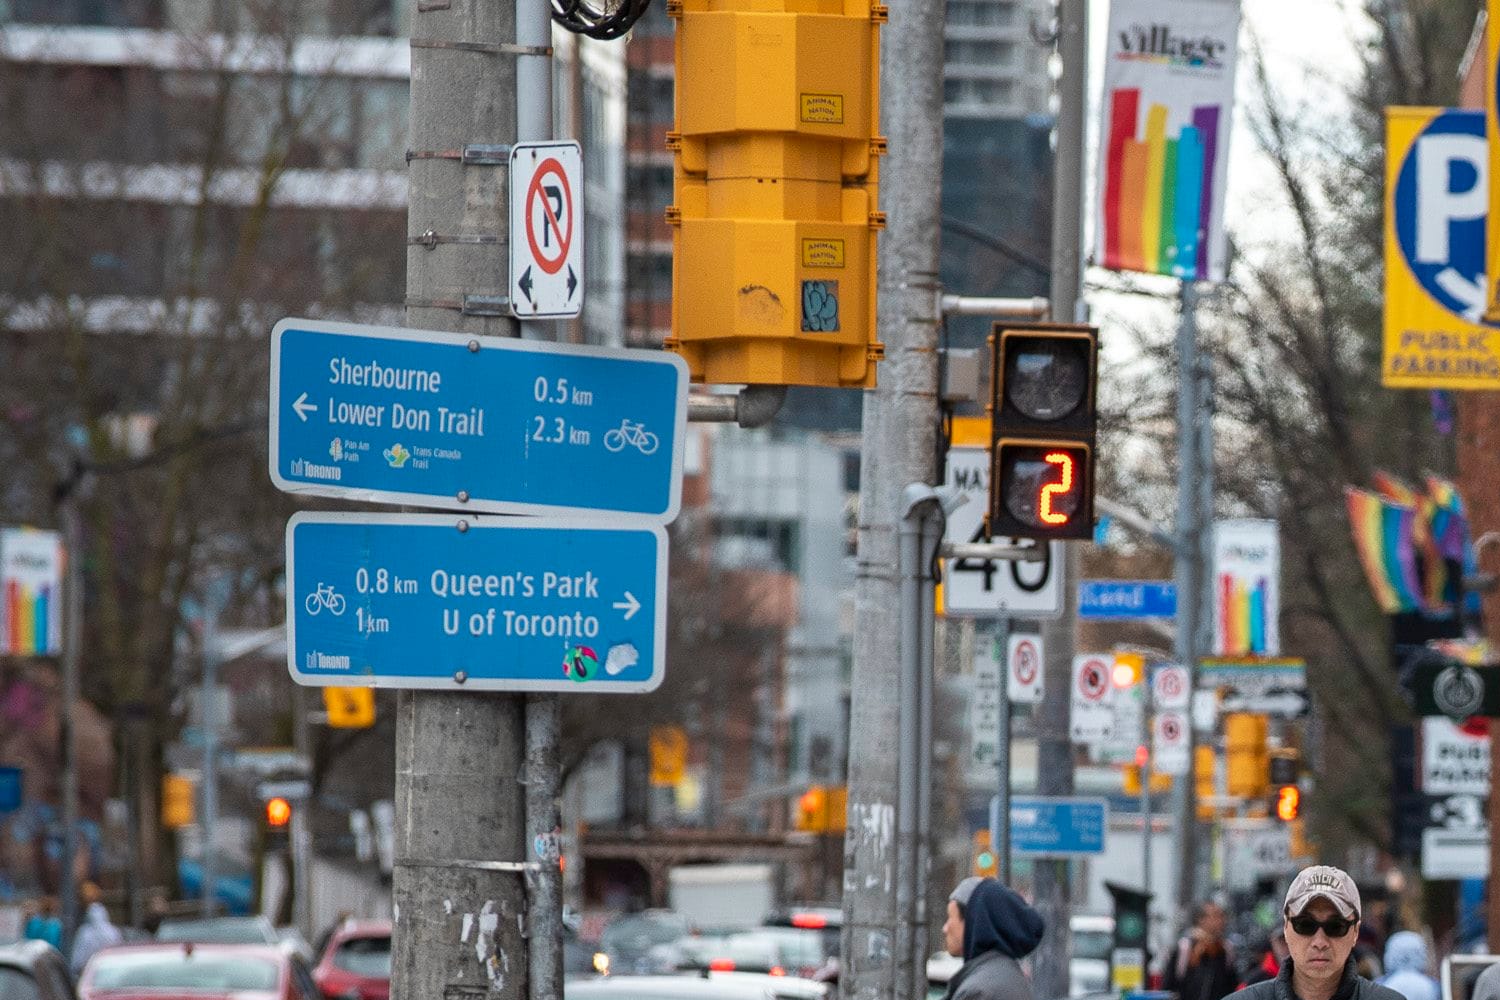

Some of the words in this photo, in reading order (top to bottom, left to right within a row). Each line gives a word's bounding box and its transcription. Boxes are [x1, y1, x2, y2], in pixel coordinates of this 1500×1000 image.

[1401, 331, 1490, 351] PUBLIC
[329, 357, 441, 394] Sherbourne
[1391, 356, 1500, 378] PARKING
[534, 376, 568, 404] 0.5
[571, 387, 593, 406] km
[328, 397, 385, 428] Lower
[392, 403, 430, 431] Don
[438, 407, 485, 437] Trail
[532, 415, 566, 444] 2.3
[568, 426, 591, 445] km
[344, 440, 356, 450] Pan
[358, 442, 370, 452] Am
[344, 452, 360, 463] Path
[412, 445, 432, 457] Trans
[433, 448, 462, 461] Canada
[303, 461, 342, 481] TORONTO
[412, 459, 429, 470] Trail
[1038, 453, 1072, 525] 2
[355, 567, 389, 594] 0.8
[393, 575, 419, 595] km
[430, 570, 535, 598] Queen's
[542, 571, 600, 599] Park
[355, 607, 366, 632] 1
[366, 615, 390, 633] km
[442, 609, 460, 635] U
[468, 608, 497, 636] of
[502, 610, 600, 637] Toronto
